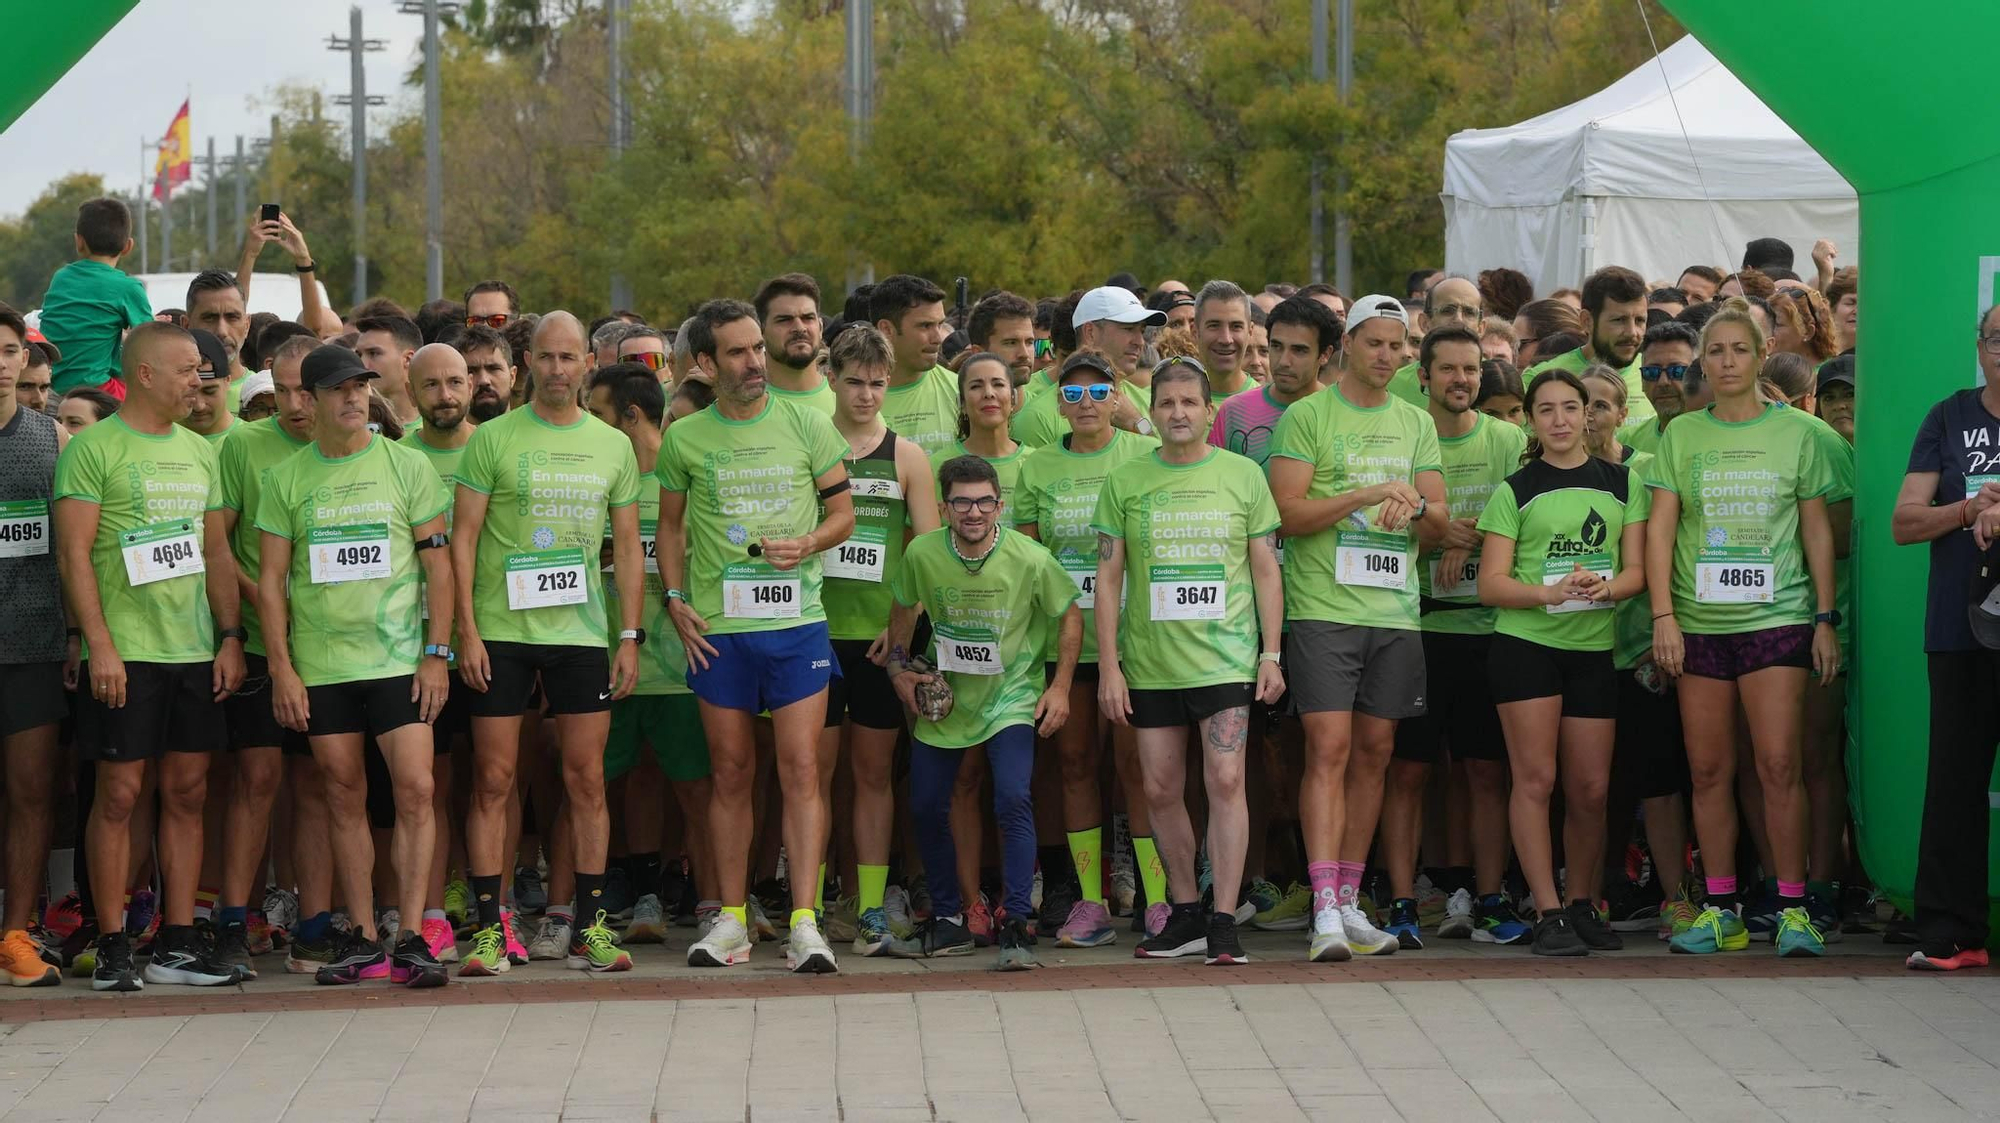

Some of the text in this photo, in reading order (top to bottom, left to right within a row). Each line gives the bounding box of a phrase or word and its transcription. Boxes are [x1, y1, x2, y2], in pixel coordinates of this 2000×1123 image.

[1962, 426, 1991, 448] VA
[1348, 453, 1364, 466] En
[532, 470, 609, 486] En marcha
[718, 464, 795, 481] En marcha
[1703, 470, 1720, 481] En
[145, 480, 163, 492] En
[532, 484, 589, 500] contra
[719, 481, 775, 498] contra
[1702, 484, 1759, 498] contra
[317, 500, 394, 519] En marcha
[853, 506, 890, 518] ORDOBÉS
[1054, 506, 1095, 519] cont
[1153, 508, 1231, 522] En marcha
[0, 521, 42, 542] 4695
[312, 530, 343, 538] Córdoba
[1152, 523, 1230, 539] contra el
[152, 541, 194, 564] 4684
[1154, 540, 1229, 559] cáncer
[1548, 538, 1583, 552] ruta
[336, 545, 382, 566] 4992
[509, 555, 539, 565] Córdoba
[838, 545, 877, 566] 1485
[1363, 554, 1399, 575] 1048
[1546, 560, 1575, 568] Córdoba
[537, 570, 579, 592] 2132
[1719, 568, 1766, 587] 4865
[751, 585, 793, 604] 1460
[1176, 586, 1217, 606] 3647
[947, 606, 964, 616] En
[955, 645, 993, 662] 4852
